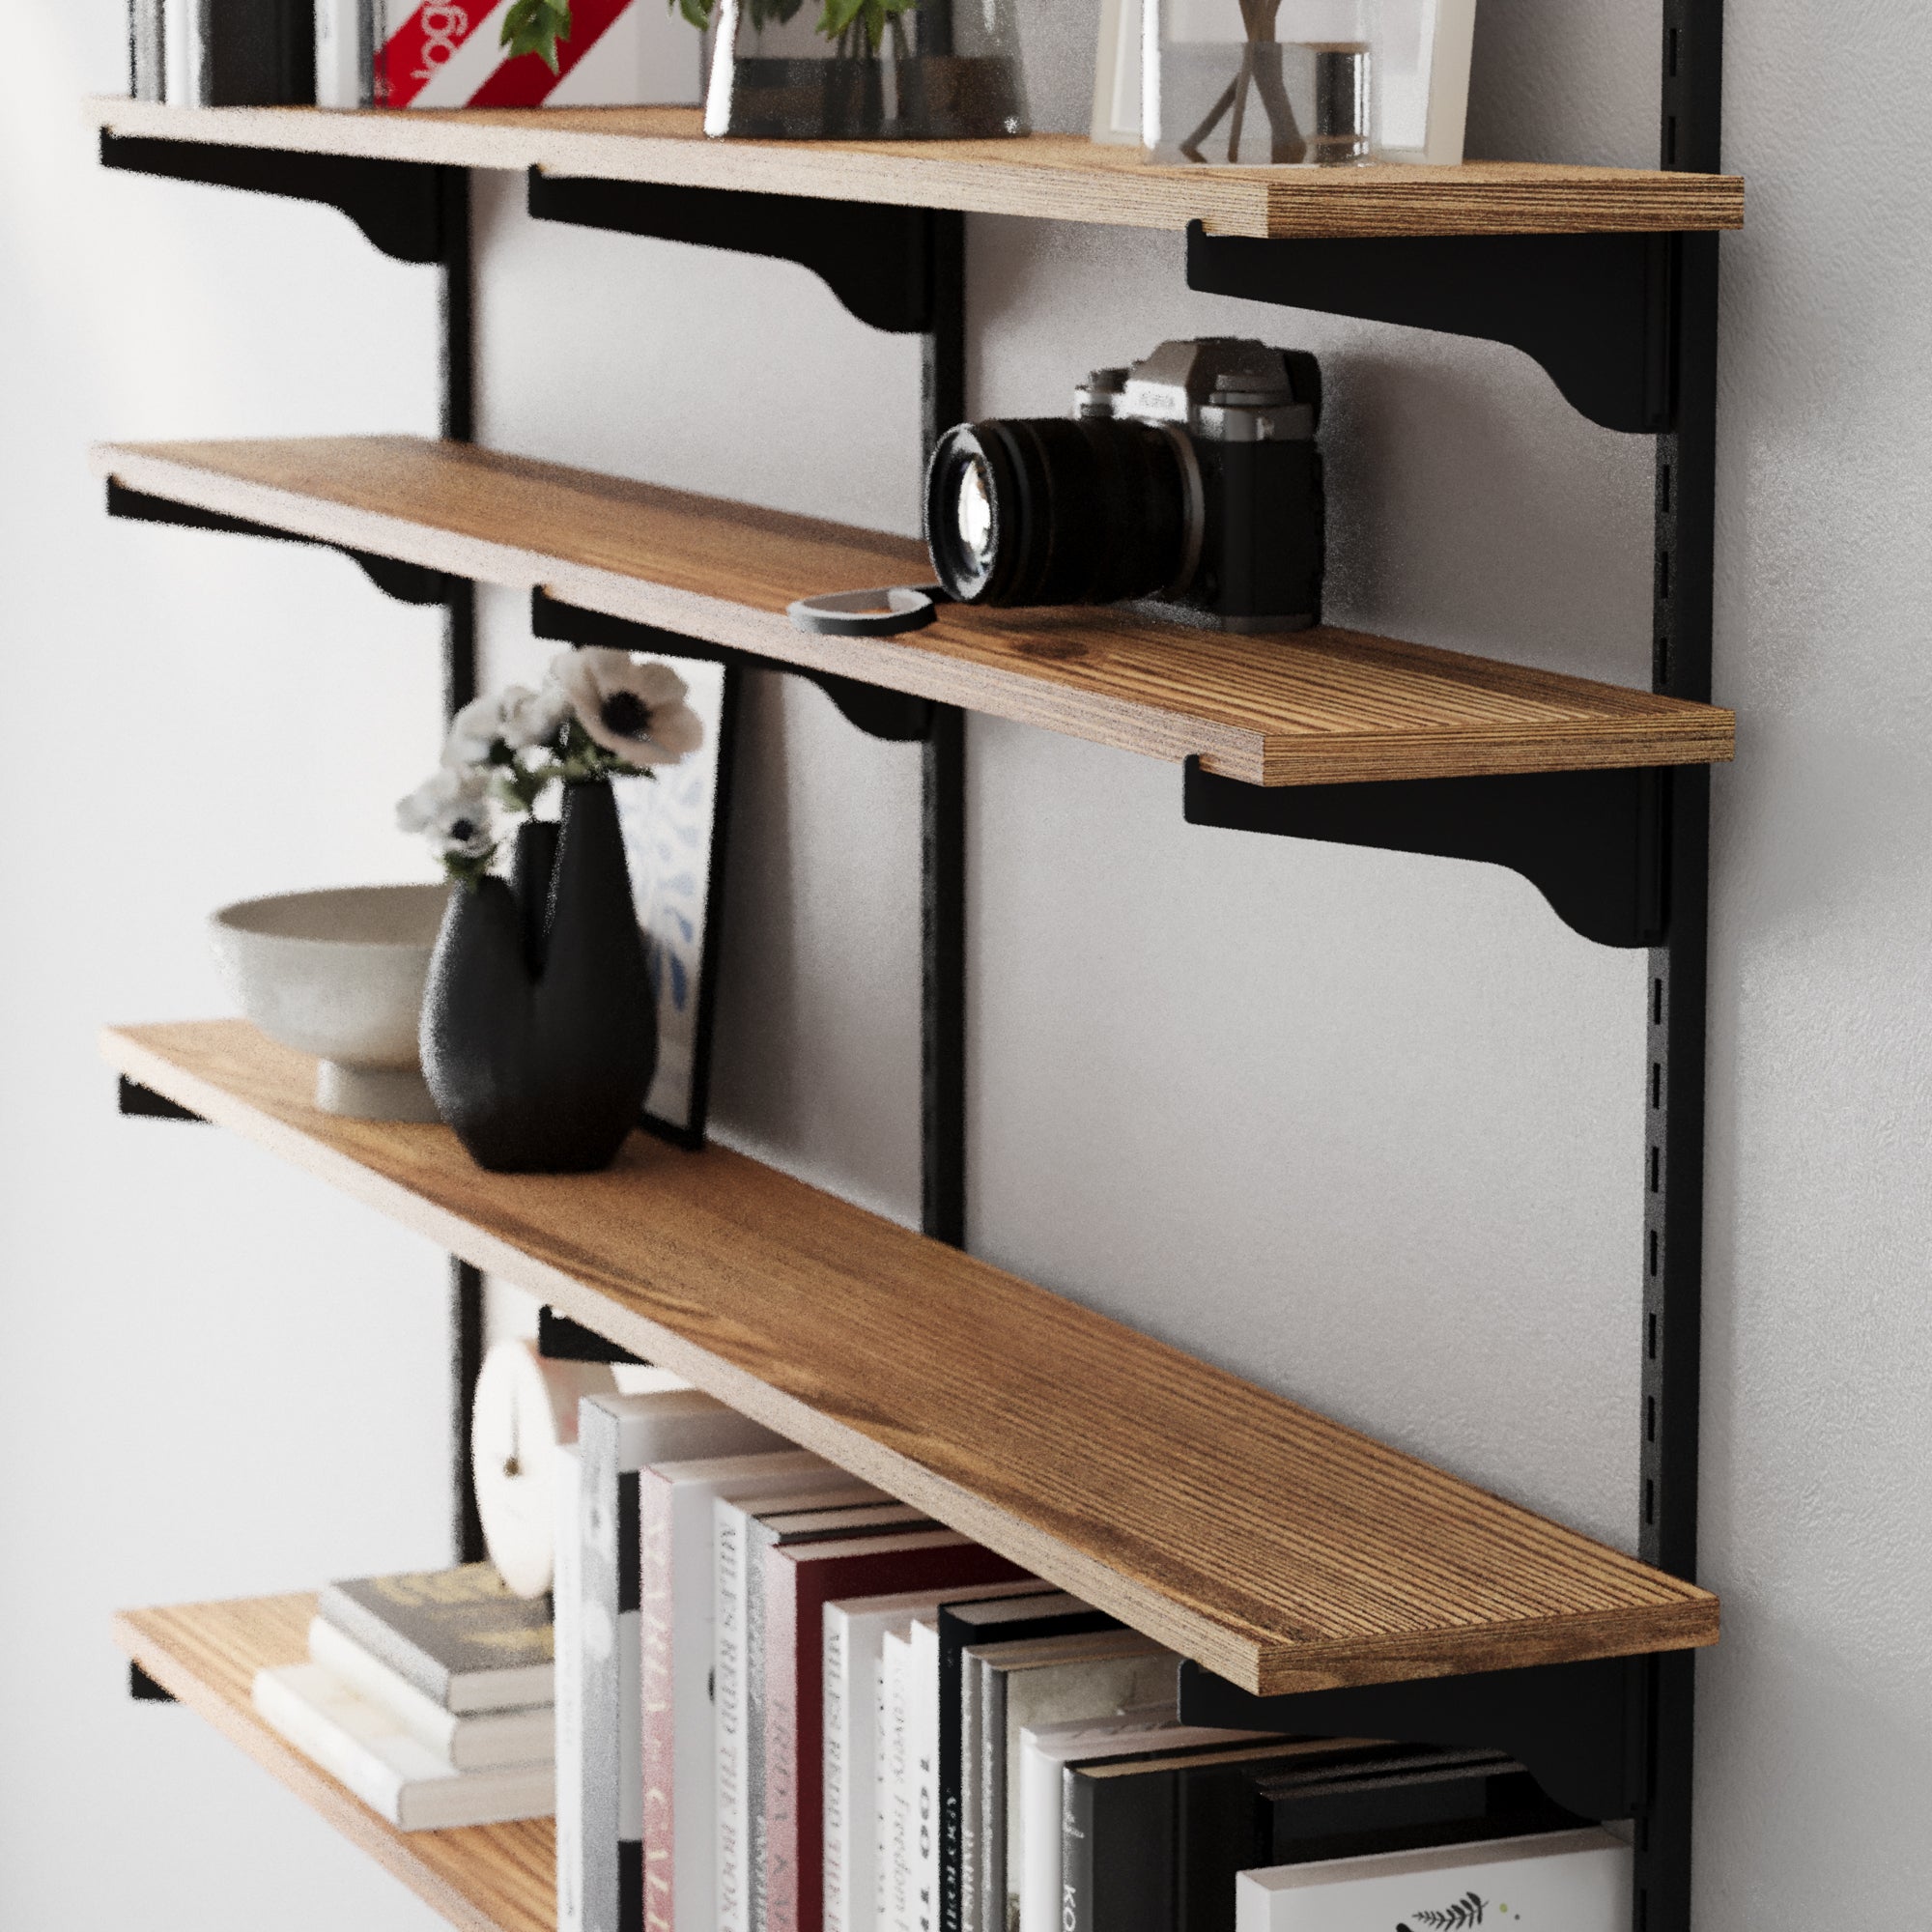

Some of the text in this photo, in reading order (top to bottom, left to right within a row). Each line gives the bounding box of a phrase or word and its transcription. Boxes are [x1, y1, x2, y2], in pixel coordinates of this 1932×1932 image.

[720, 1520, 738, 1627] MILES
[720, 1635, 738, 1733] REDD
[826, 1630, 842, 1727] MILES
[720, 1740, 738, 1814] THE
[826, 1736, 842, 1830] REDD
[893, 1791, 911, 1913] Freedom
